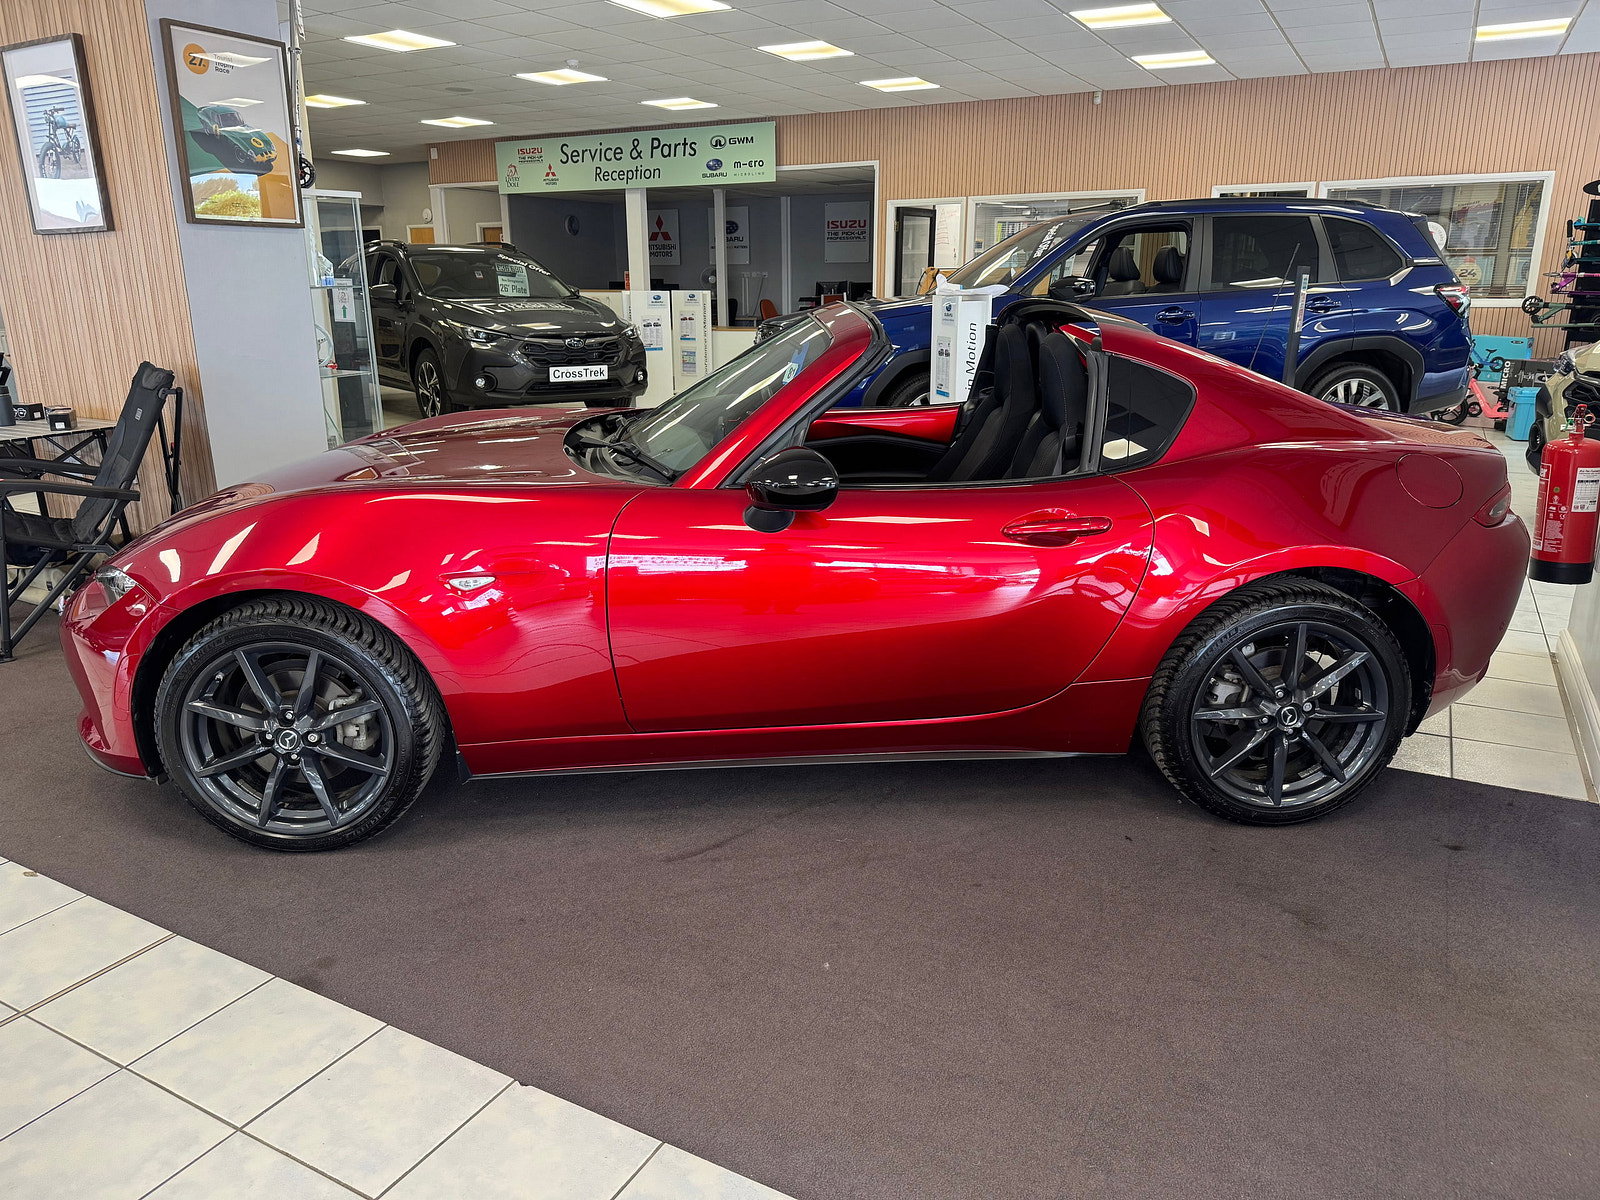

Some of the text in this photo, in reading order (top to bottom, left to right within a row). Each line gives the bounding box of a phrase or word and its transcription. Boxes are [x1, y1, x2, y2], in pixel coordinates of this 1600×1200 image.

[214, 66, 230, 74] Race
[728, 136, 754, 145] GWM
[517, 147, 543, 155] ISUZU
[560, 137, 698, 165] Service & Parts
[594, 165, 661, 185] Reception
[826, 219, 867, 229] ISUZU
[497, 253, 528, 266] Special
[1458, 268, 1477, 278] 24
[511, 285, 528, 294] Plate
[965, 322, 977, 375] Motion
[552, 367, 605, 379] CrossTrek
[1500, 360, 1511, 389] MICRO
